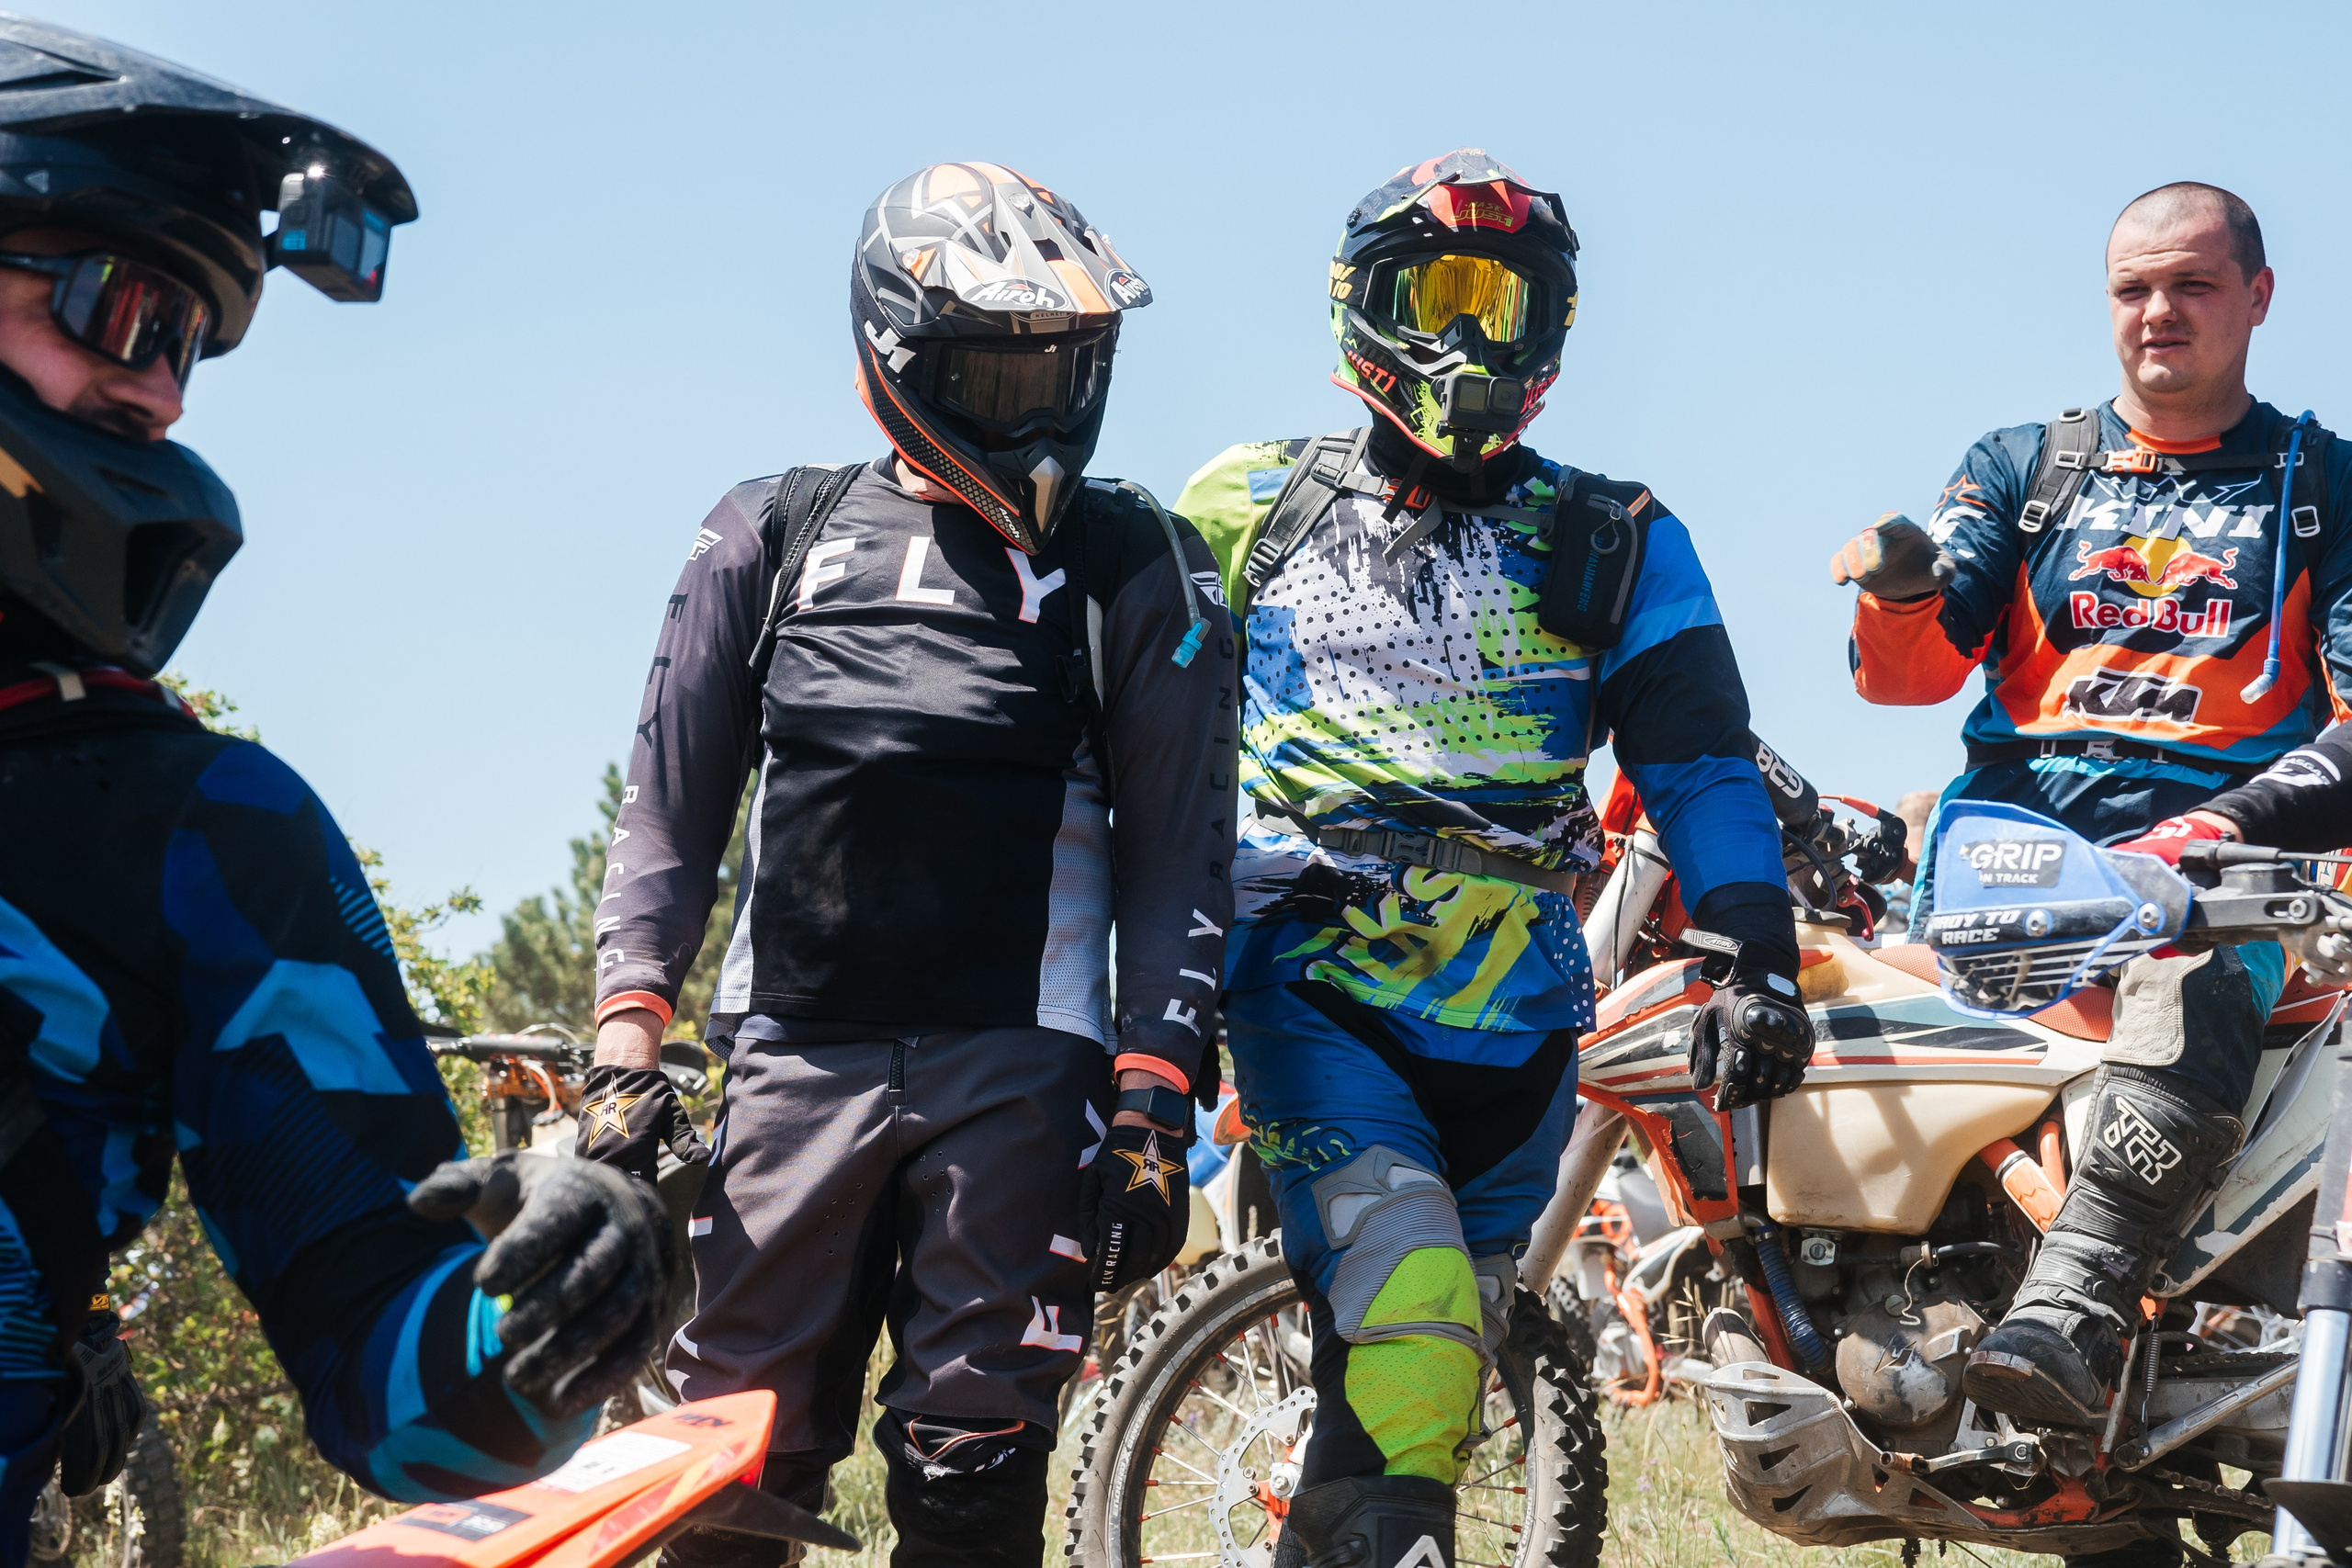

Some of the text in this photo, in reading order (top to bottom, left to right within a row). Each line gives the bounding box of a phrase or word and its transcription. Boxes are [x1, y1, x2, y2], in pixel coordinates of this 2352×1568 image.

[970, 281, 1056, 309] Airoh
[999, 507, 1020, 539] Airoh
[797, 536, 1066, 624] FLY
[2069, 591, 2233, 638] Red Bull
[2062, 666, 2203, 728] KTM
[595, 592, 689, 971] FLY RACING
[1970, 842, 2063, 871] GRIP
[1996, 873, 2039, 884] TRACK
[1941, 928, 2000, 944] RACE
[1984, 909, 2021, 926] TO
[1162, 907, 1224, 1038] FLY
[1102, 1223, 1123, 1285] FLY RACING
